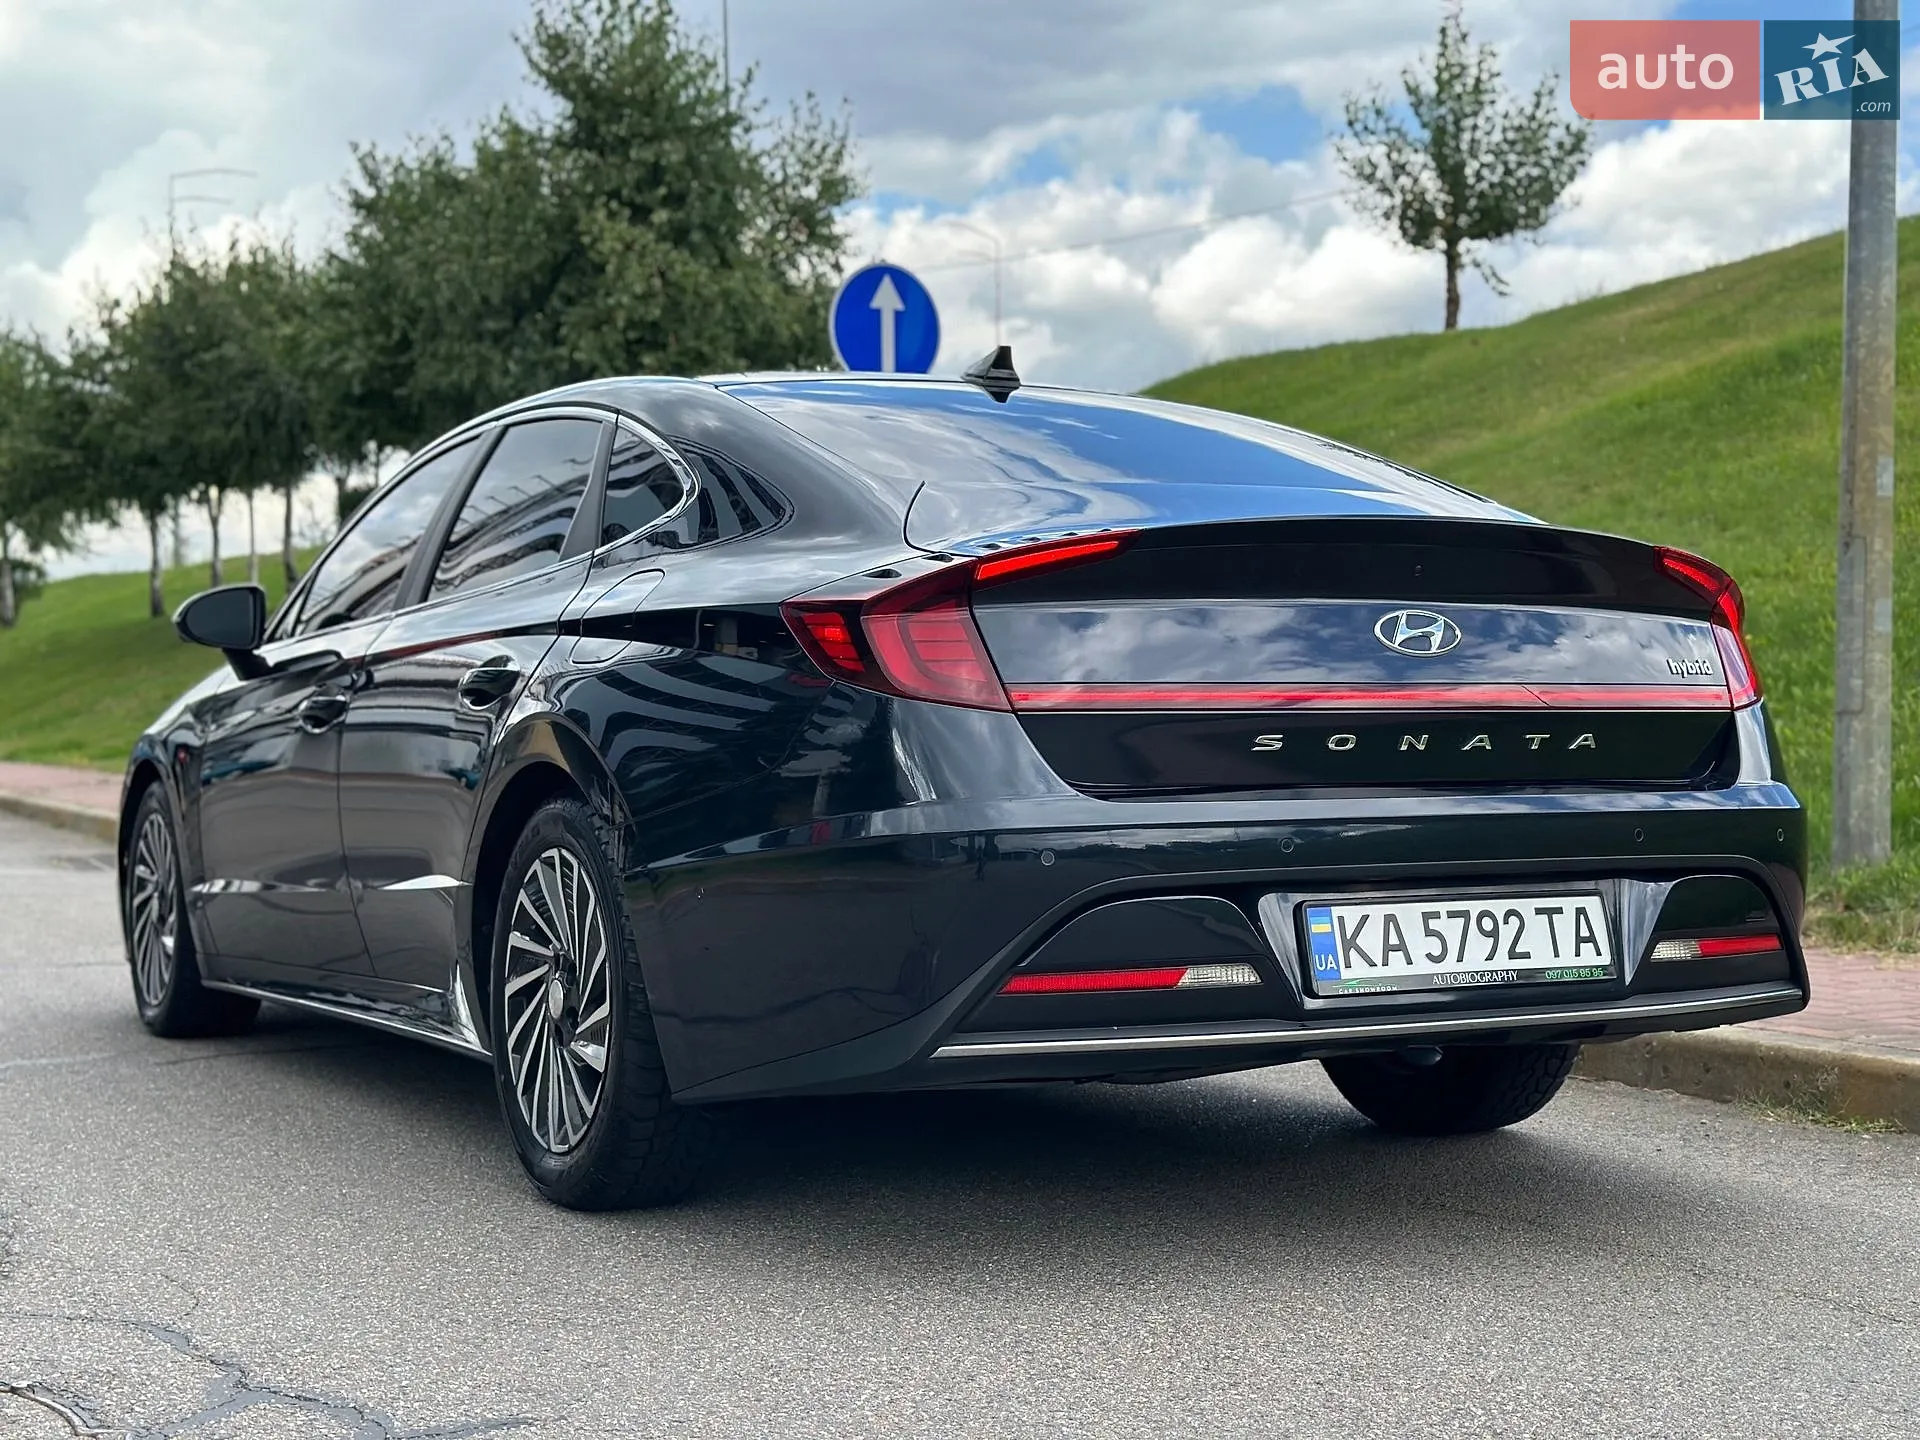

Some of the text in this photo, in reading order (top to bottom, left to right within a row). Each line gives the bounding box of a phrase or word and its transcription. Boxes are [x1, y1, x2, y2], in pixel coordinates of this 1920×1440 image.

[1668, 658, 1714, 677] hybrid
[1251, 733, 1599, 753] SONATA
[1337, 905, 1603, 969] KA 5792 TA
[1315, 954, 1338, 971] UA
[1432, 970, 1518, 985] AUTOBIOGRAPHY
